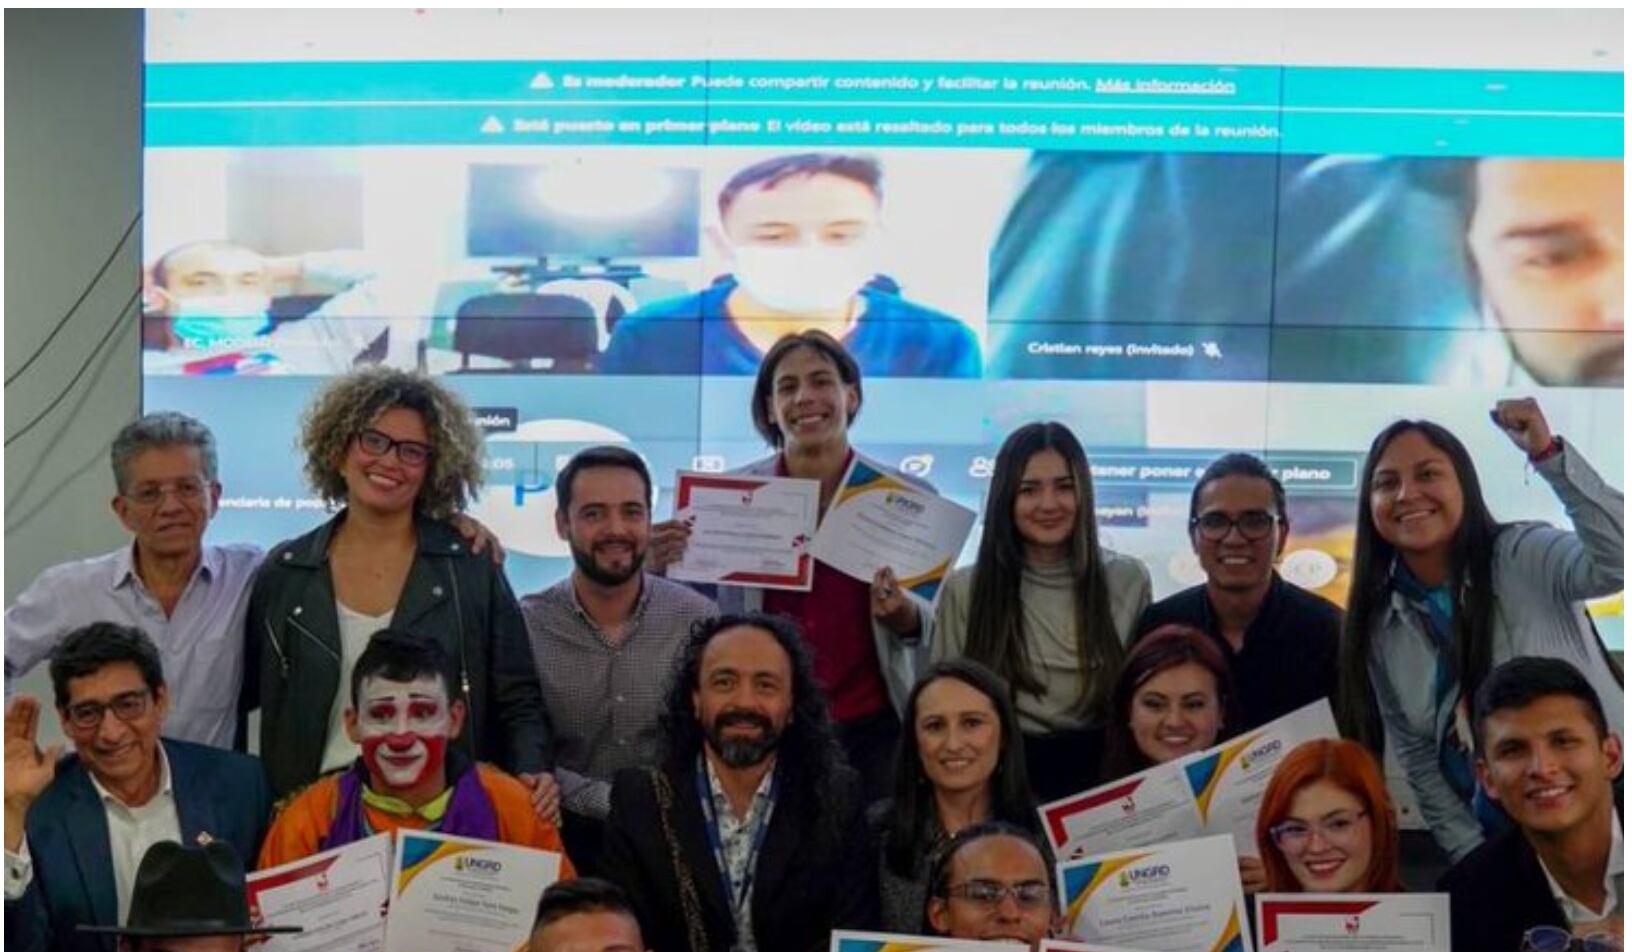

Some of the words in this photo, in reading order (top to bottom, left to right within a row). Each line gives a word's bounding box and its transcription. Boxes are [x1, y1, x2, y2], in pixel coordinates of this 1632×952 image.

[691, 76, 744, 88] Puede
[749, 77, 829, 90] compartir
[835, 77, 918, 89] contenido
[923, 80, 933, 91] y
[937, 77, 997, 90] facilitar
[1003, 78, 1018, 90] la
[645, 119, 705, 135] primer
[709, 120, 760, 135] plano
[836, 121, 871, 133] está
[876, 122, 952, 134] resaltado
[957, 123, 995, 137] para
[999, 123, 1047, 135] todos
[1050, 124, 1076, 135] los
[1081, 124, 1164, 136] miembros
[1169, 125, 1190, 137] de
[1194, 125, 1210, 137] la
[1027, 341, 1082, 354] Cristian
[1085, 345, 1123, 358] reyes
[1139, 466, 1192, 482] poner
[1282, 465, 1331, 483] plano
[1129, 865, 1170, 880] UNGRD
